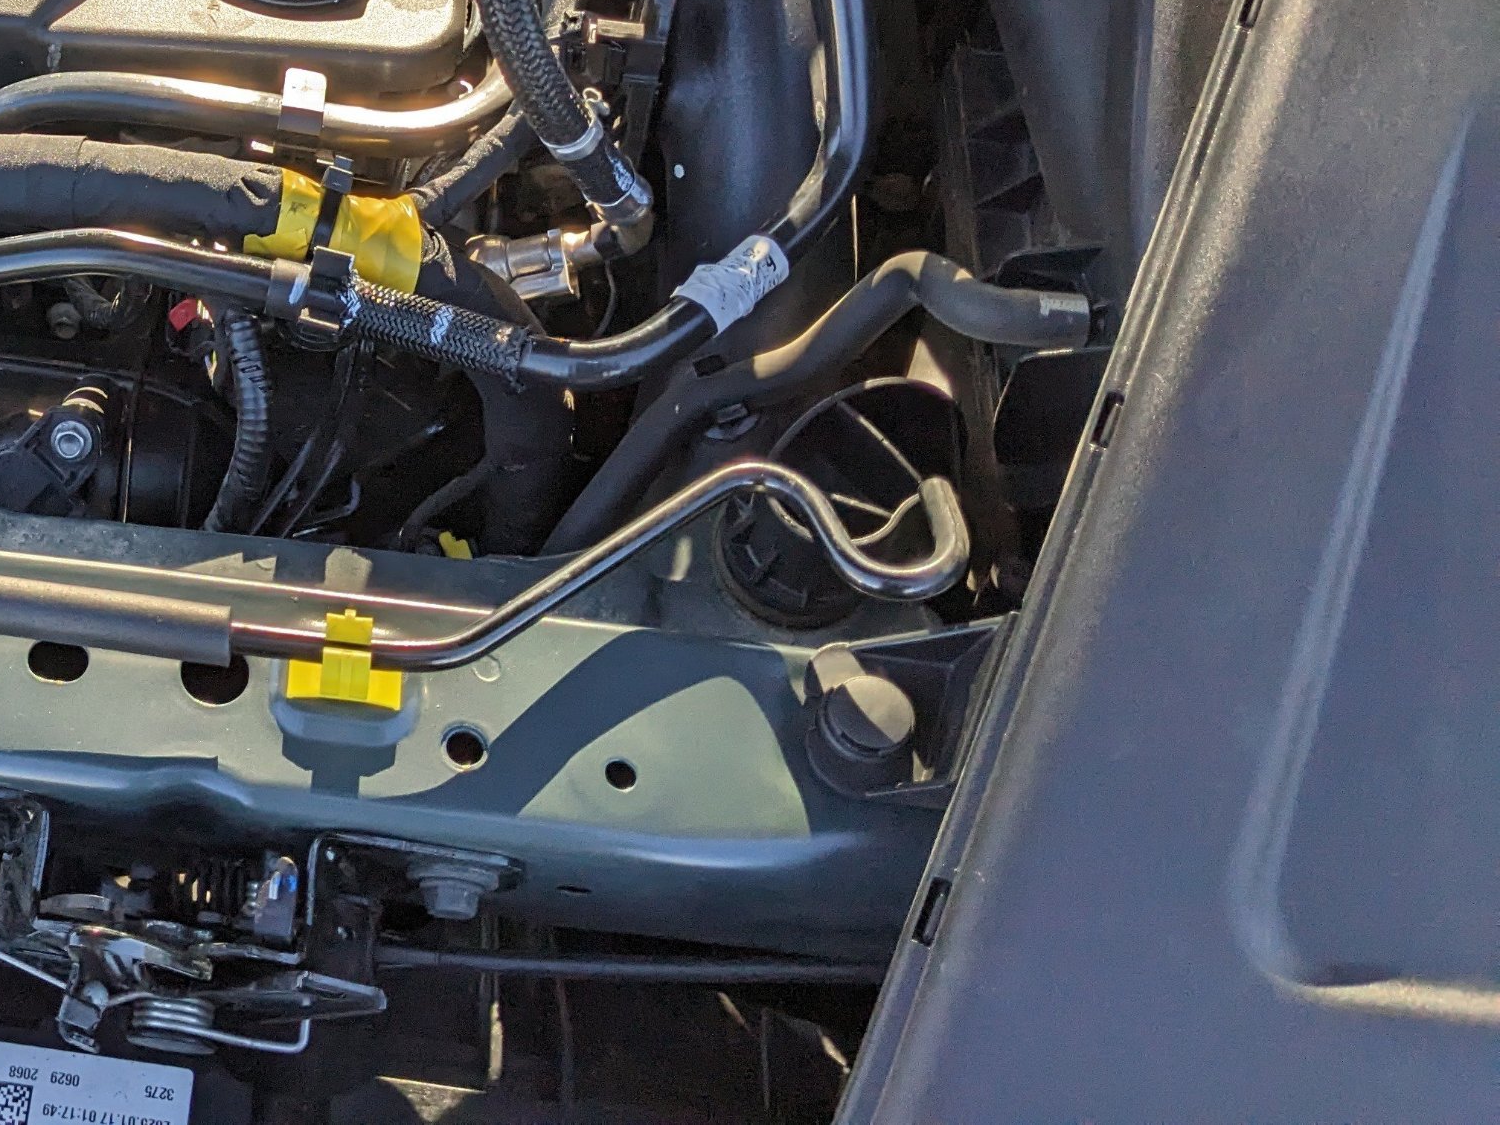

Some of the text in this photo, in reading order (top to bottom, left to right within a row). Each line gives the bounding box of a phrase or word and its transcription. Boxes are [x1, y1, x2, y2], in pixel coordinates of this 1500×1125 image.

[8, 1065, 175, 1101] 3275 0629 2068
[42, 1103, 97, 1123] 01:17:49
